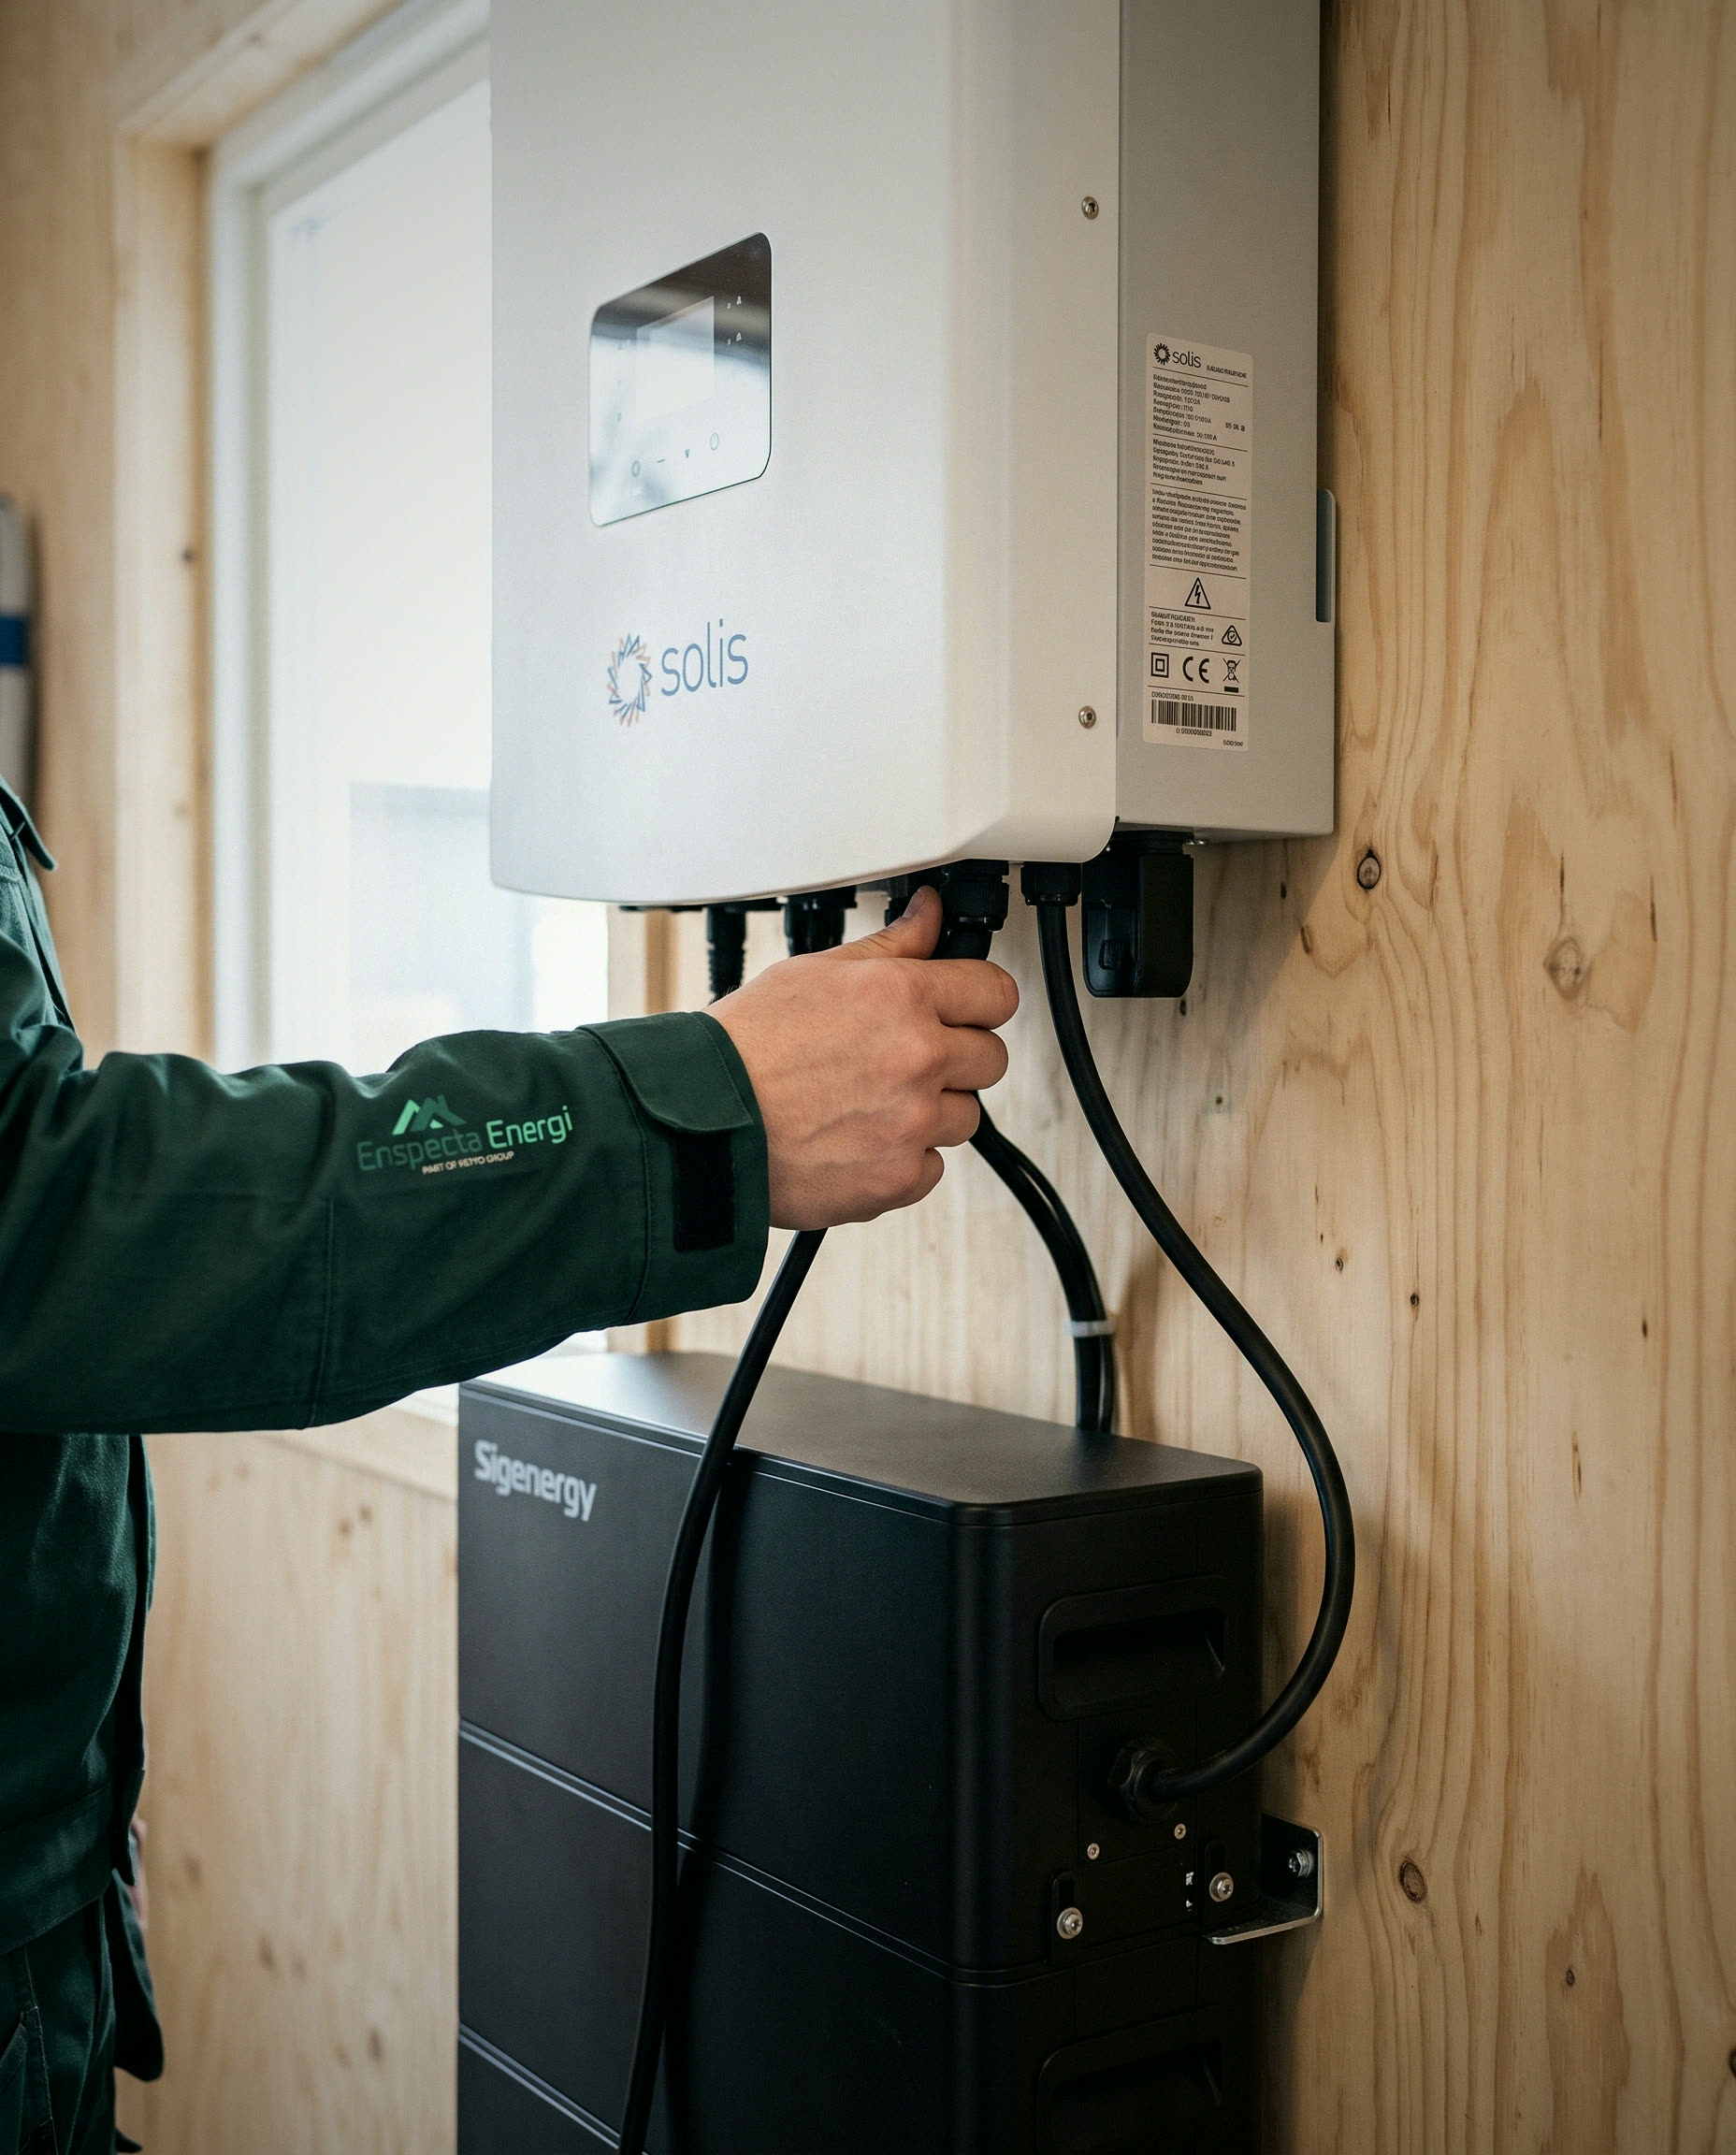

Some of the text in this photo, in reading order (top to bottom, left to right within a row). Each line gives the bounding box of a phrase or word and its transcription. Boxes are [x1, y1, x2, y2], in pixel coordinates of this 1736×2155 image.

[1172, 351, 1202, 369] solis
[660, 618, 749, 697] solis
[356, 1105, 573, 1171] Enspecta Energi
[473, 1439, 598, 1523] Sigenergy
